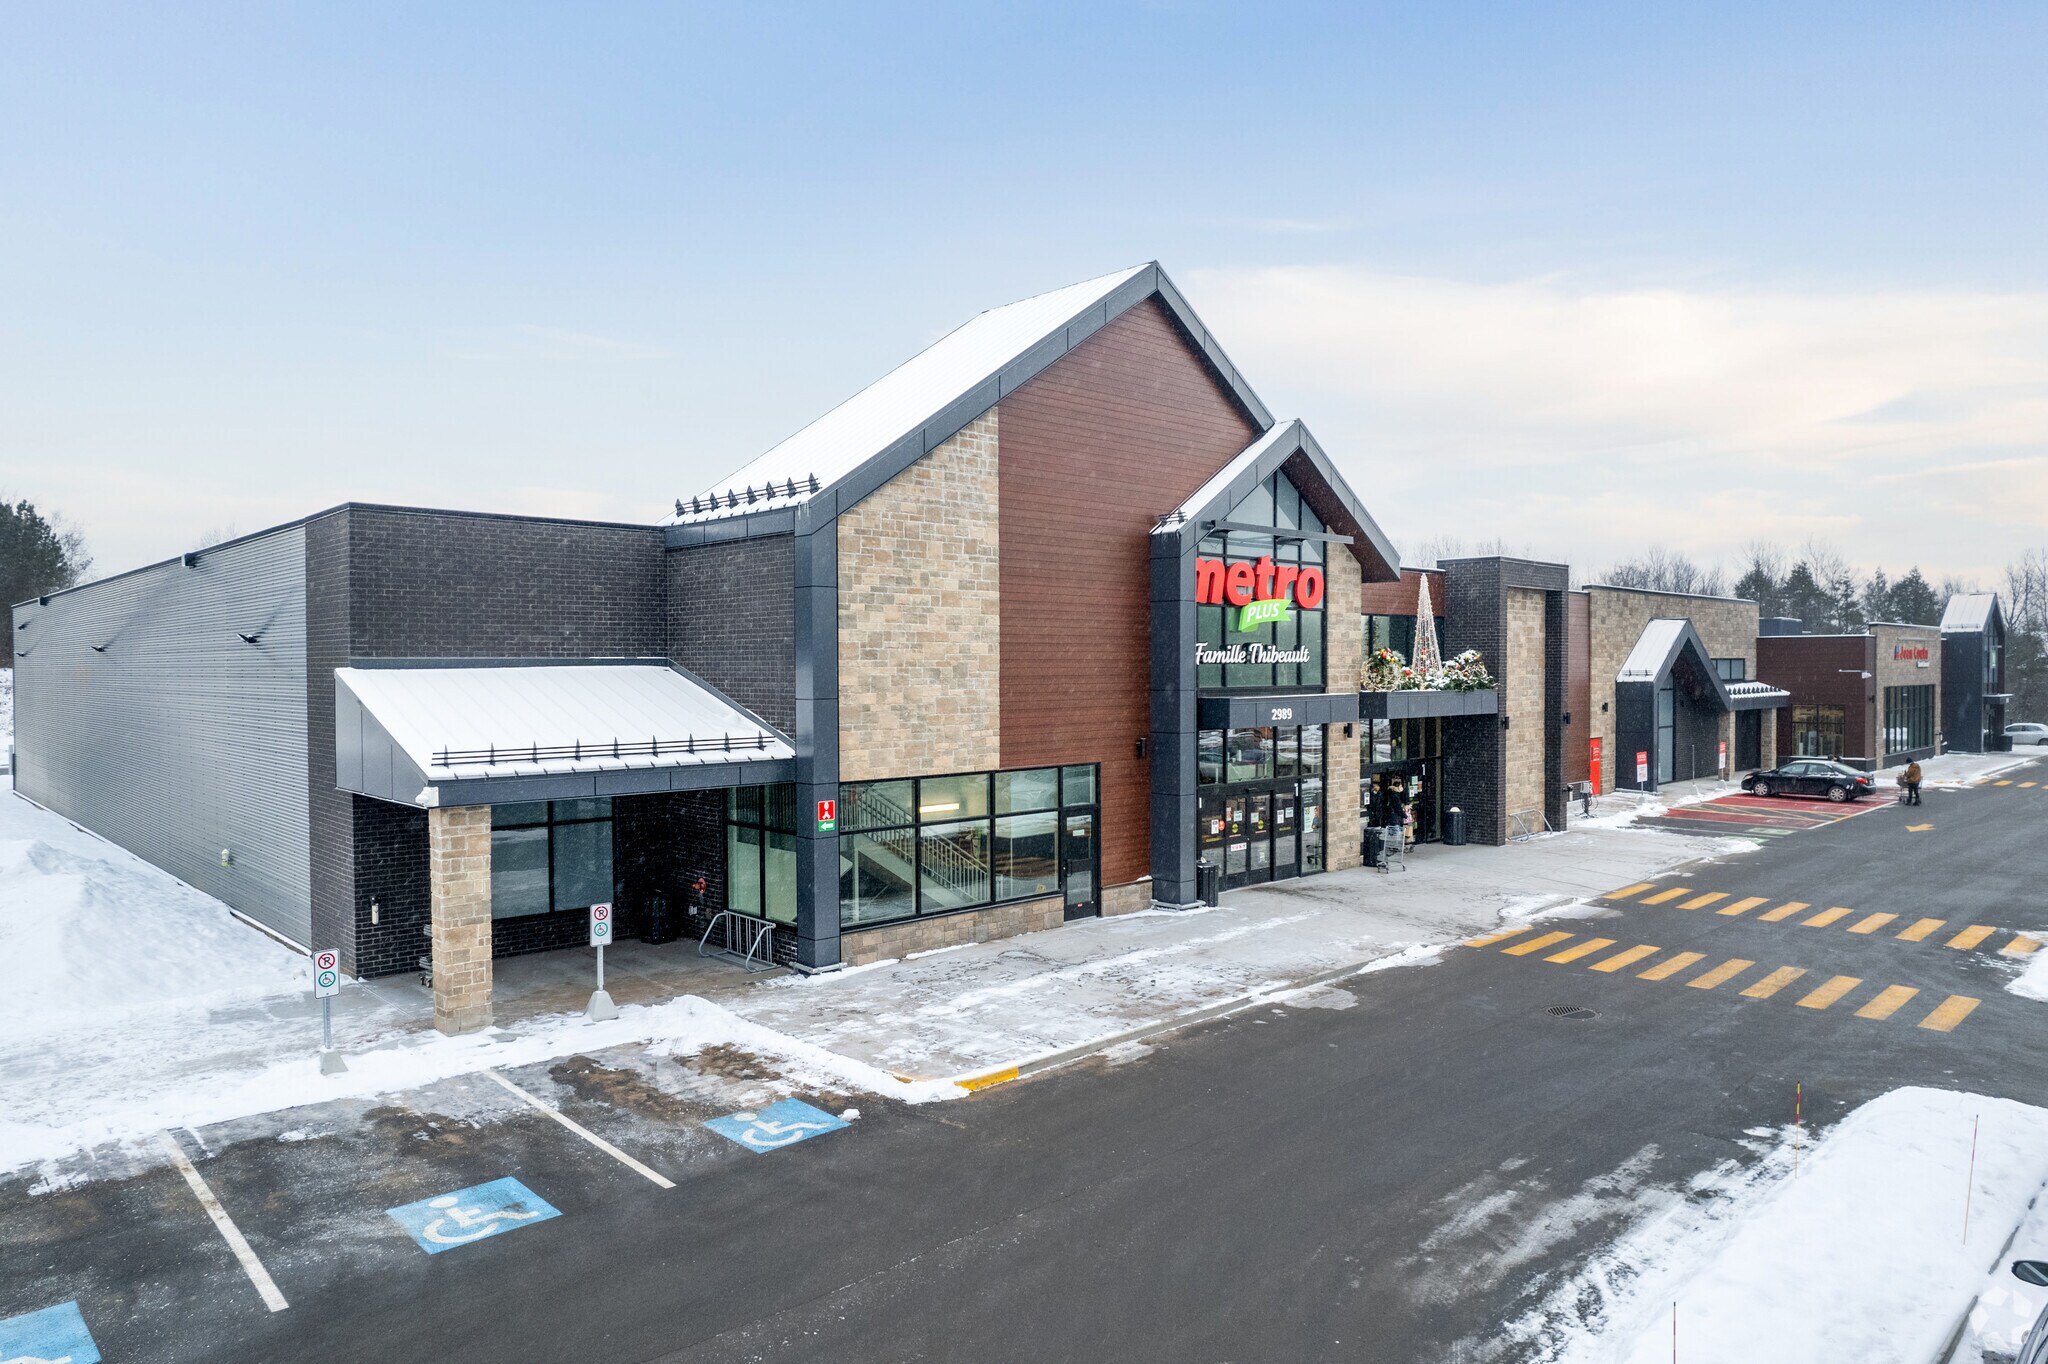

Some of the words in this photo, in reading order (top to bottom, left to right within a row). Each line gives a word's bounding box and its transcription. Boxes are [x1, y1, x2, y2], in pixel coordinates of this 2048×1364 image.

[1196, 555, 1324, 608] metro
[1246, 602, 1280, 623] PLUS
[1195, 642, 1246, 665] Famille
[1248, 642, 1310, 664] Thibeault
[1271, 708, 1293, 721] 2989
